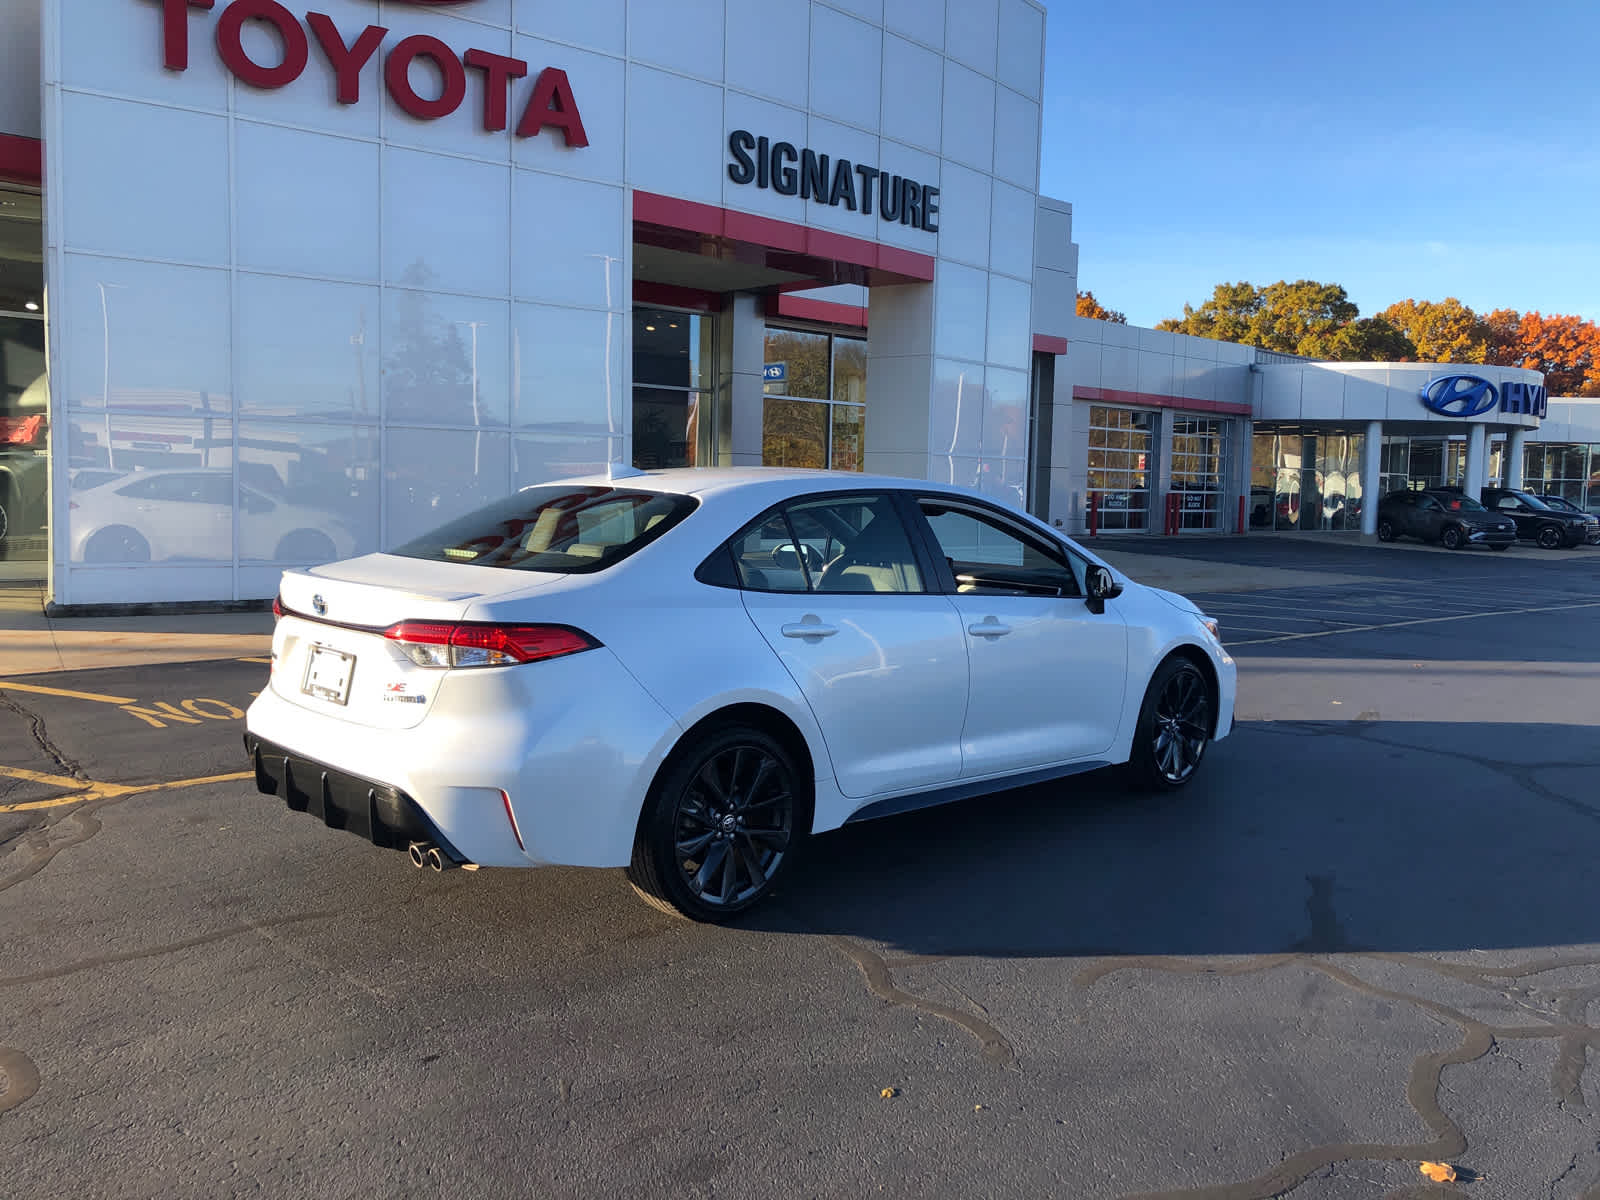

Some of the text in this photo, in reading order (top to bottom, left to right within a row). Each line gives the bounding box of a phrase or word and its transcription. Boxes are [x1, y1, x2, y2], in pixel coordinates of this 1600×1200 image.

[161, 0, 590, 148] TOYOTA
[728, 129, 940, 233] SIGNATURE
[119, 697, 246, 729] NO
